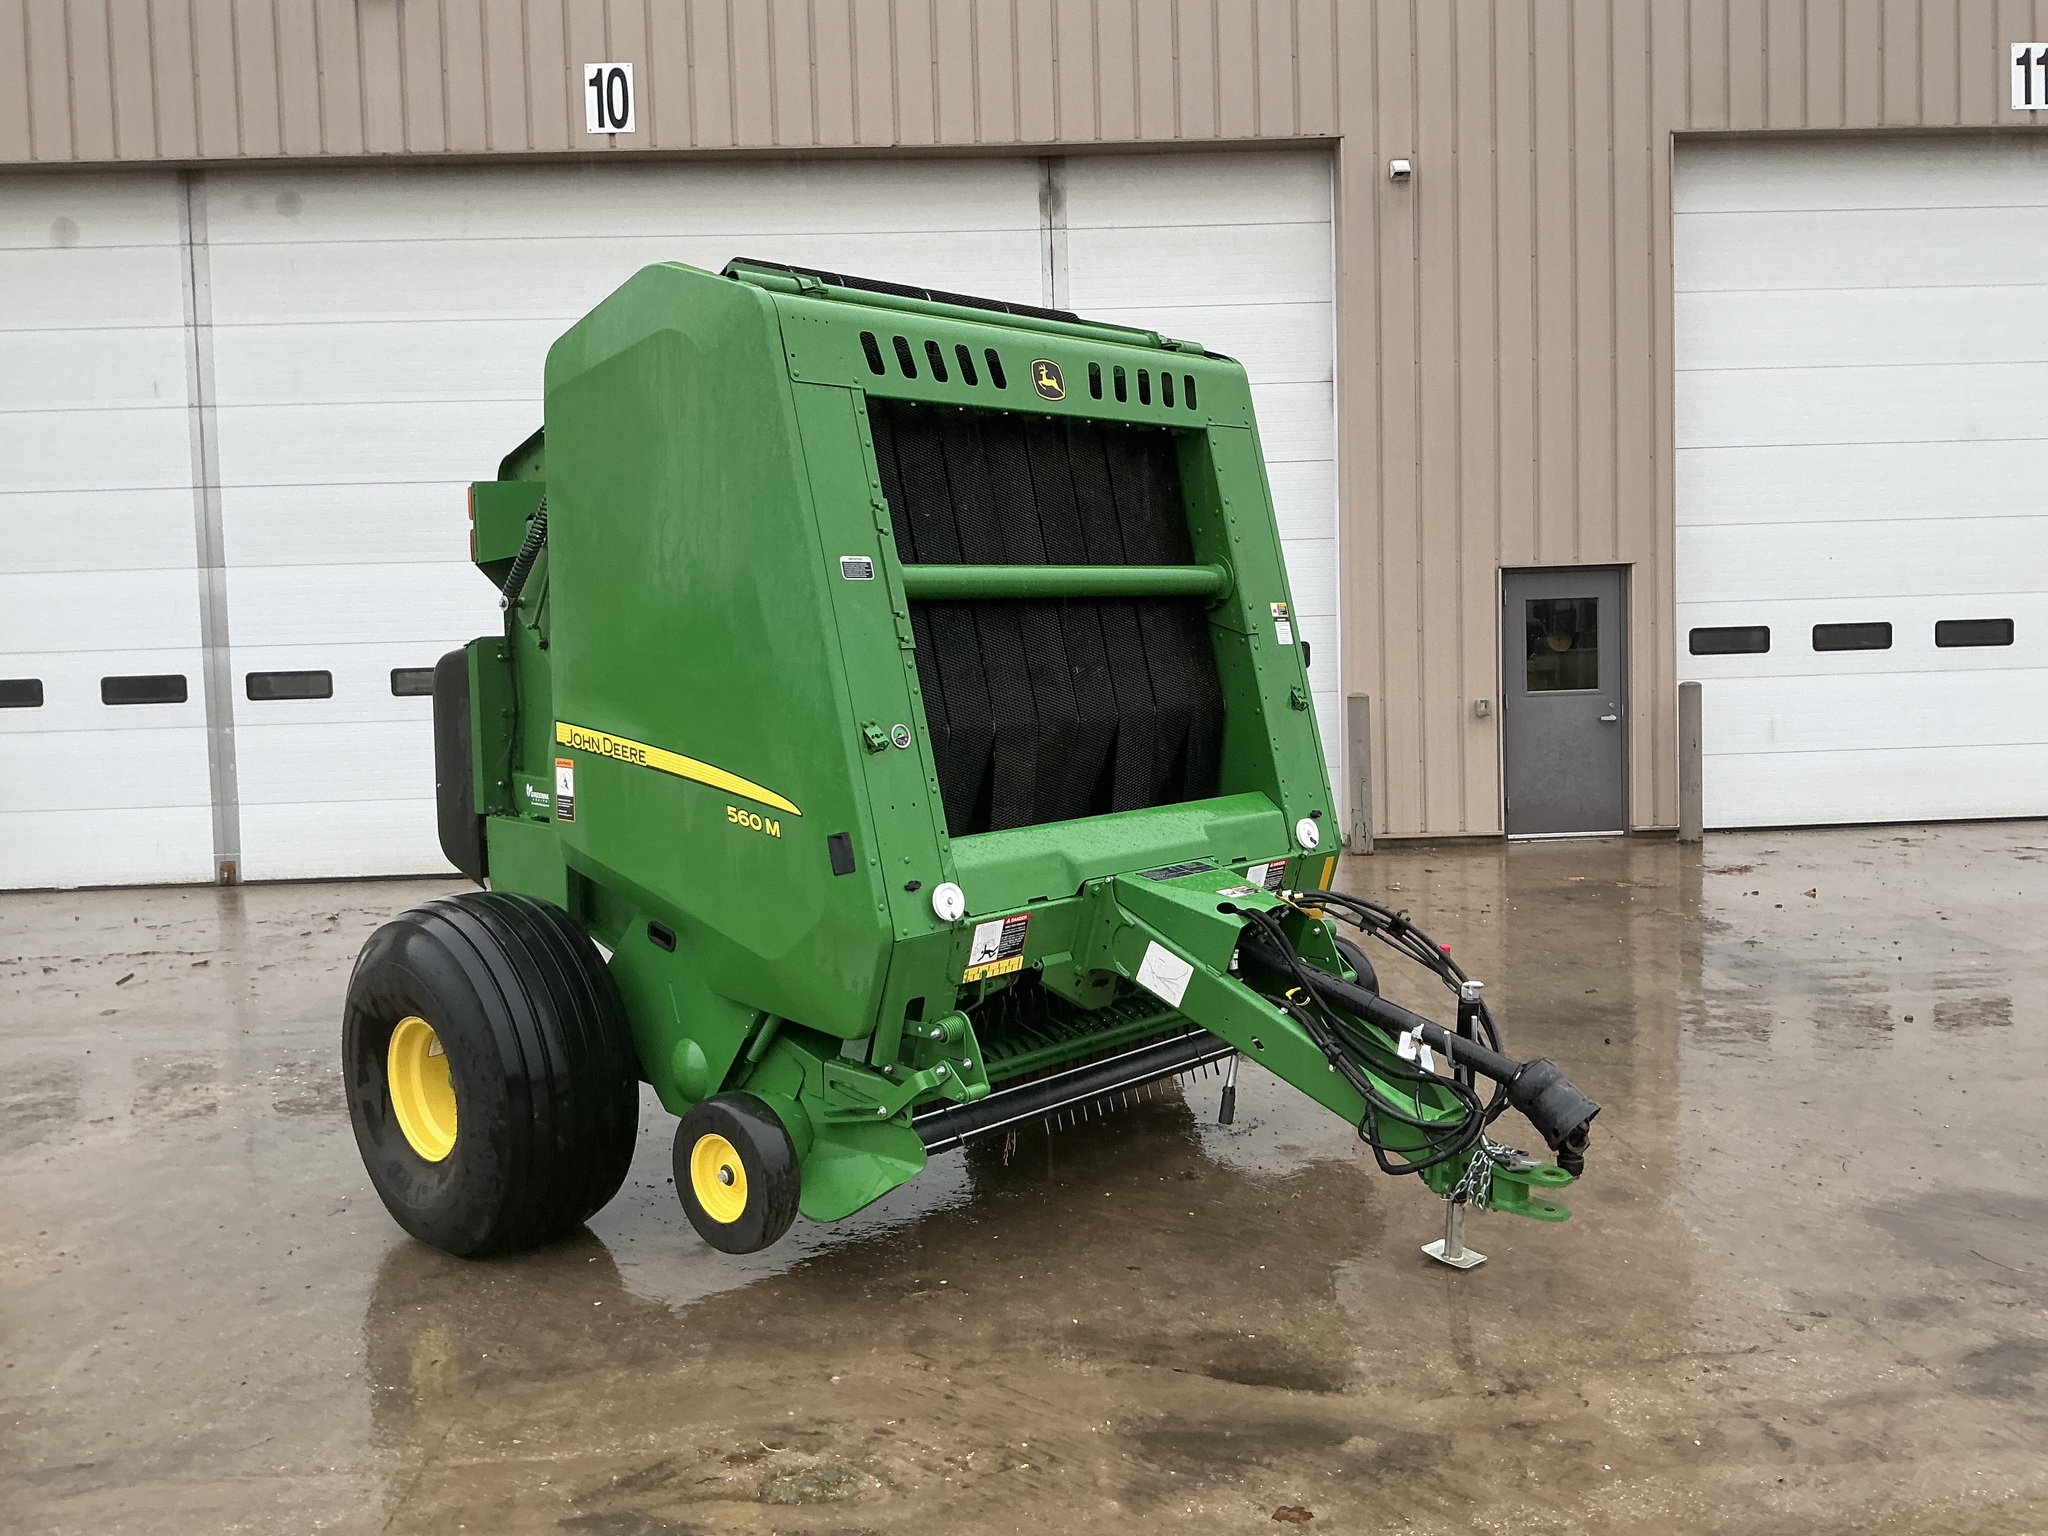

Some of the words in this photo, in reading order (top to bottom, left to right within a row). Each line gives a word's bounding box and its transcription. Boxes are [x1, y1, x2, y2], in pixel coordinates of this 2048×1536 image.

[589, 67, 629, 129] 10
[2016, 47, 2048, 105] 11
[566, 729, 600, 751] JOHN
[603, 737, 646, 764] DEERE
